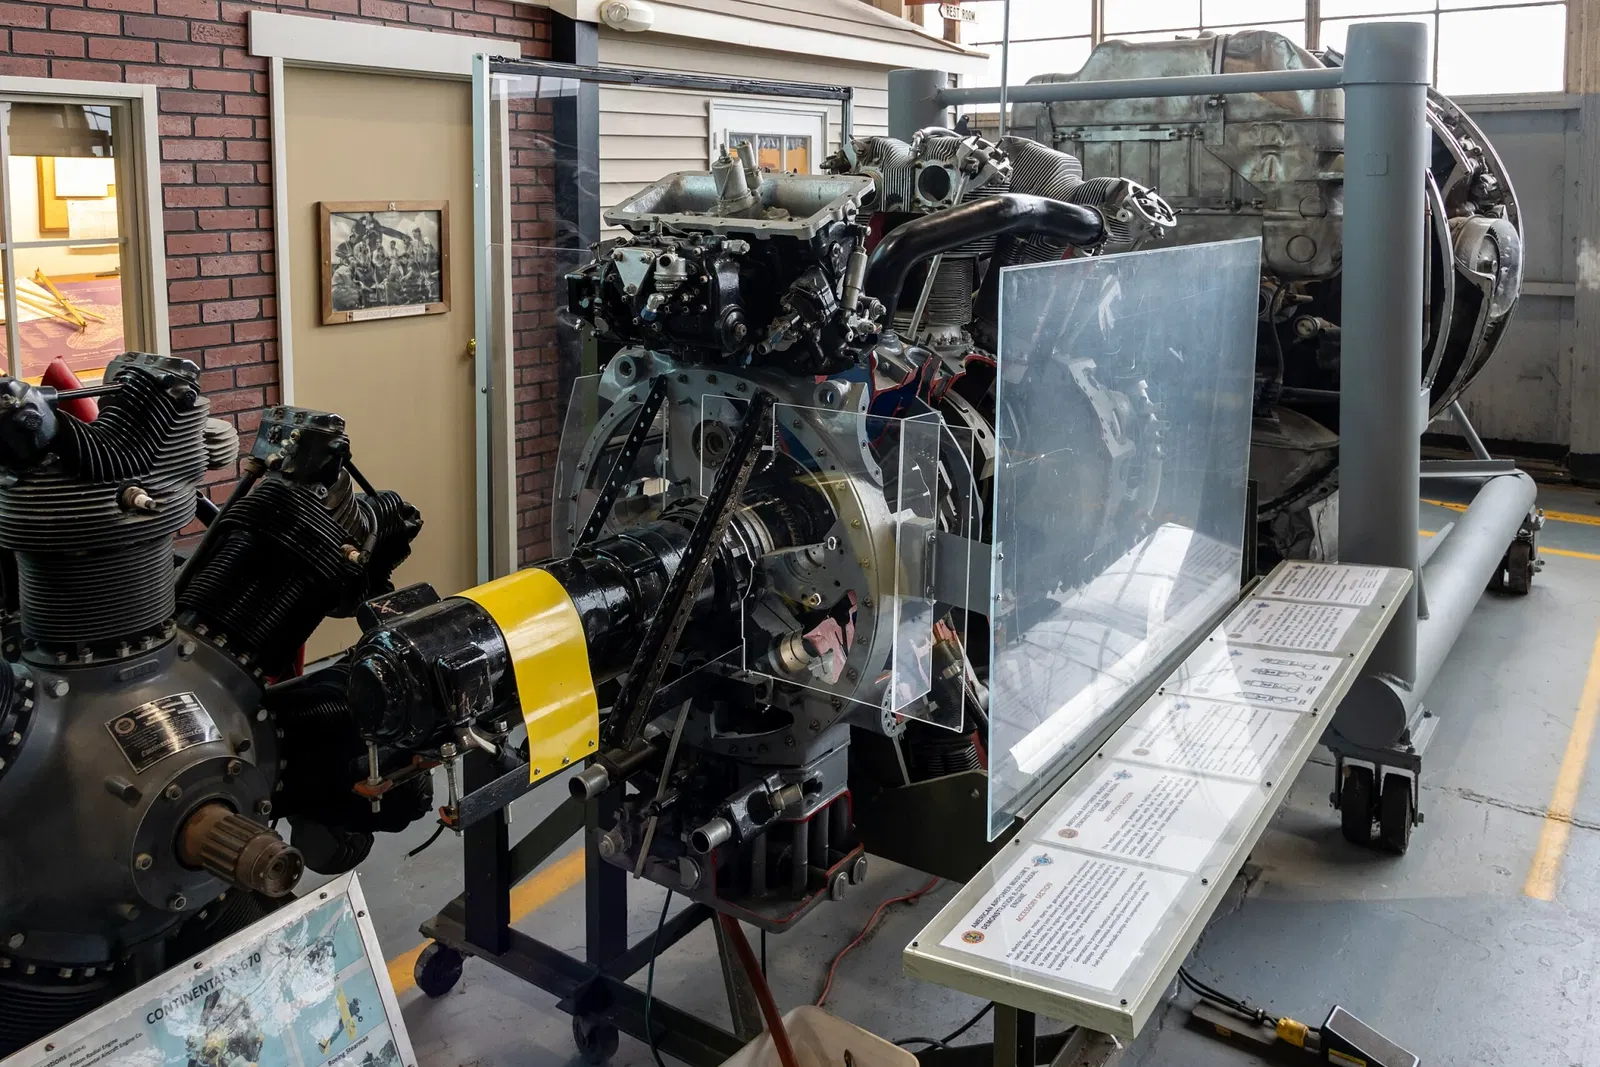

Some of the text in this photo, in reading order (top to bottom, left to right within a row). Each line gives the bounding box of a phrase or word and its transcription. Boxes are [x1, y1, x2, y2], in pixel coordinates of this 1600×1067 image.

[946, 5, 976, 22] REST ROOM
[972, 907, 993, 928] AMERICAN
[991, 886, 1011, 907] AIRPOWER
[981, 896, 1014, 930] DEMONSTRATION
[1010, 893, 1027, 908] ENGINE
[1016, 883, 1053, 922] ACCESSORY SECTION
[146, 952, 261, 1024] CONTINENTAL R-670
[86, 1047, 101, 1058] Radial
[102, 1038, 118, 1050] Engine
[101, 1045, 119, 1059] Aircraft
[119, 1036, 135, 1049] Engine
[327, 1035, 370, 1067] Boeing Stearman
